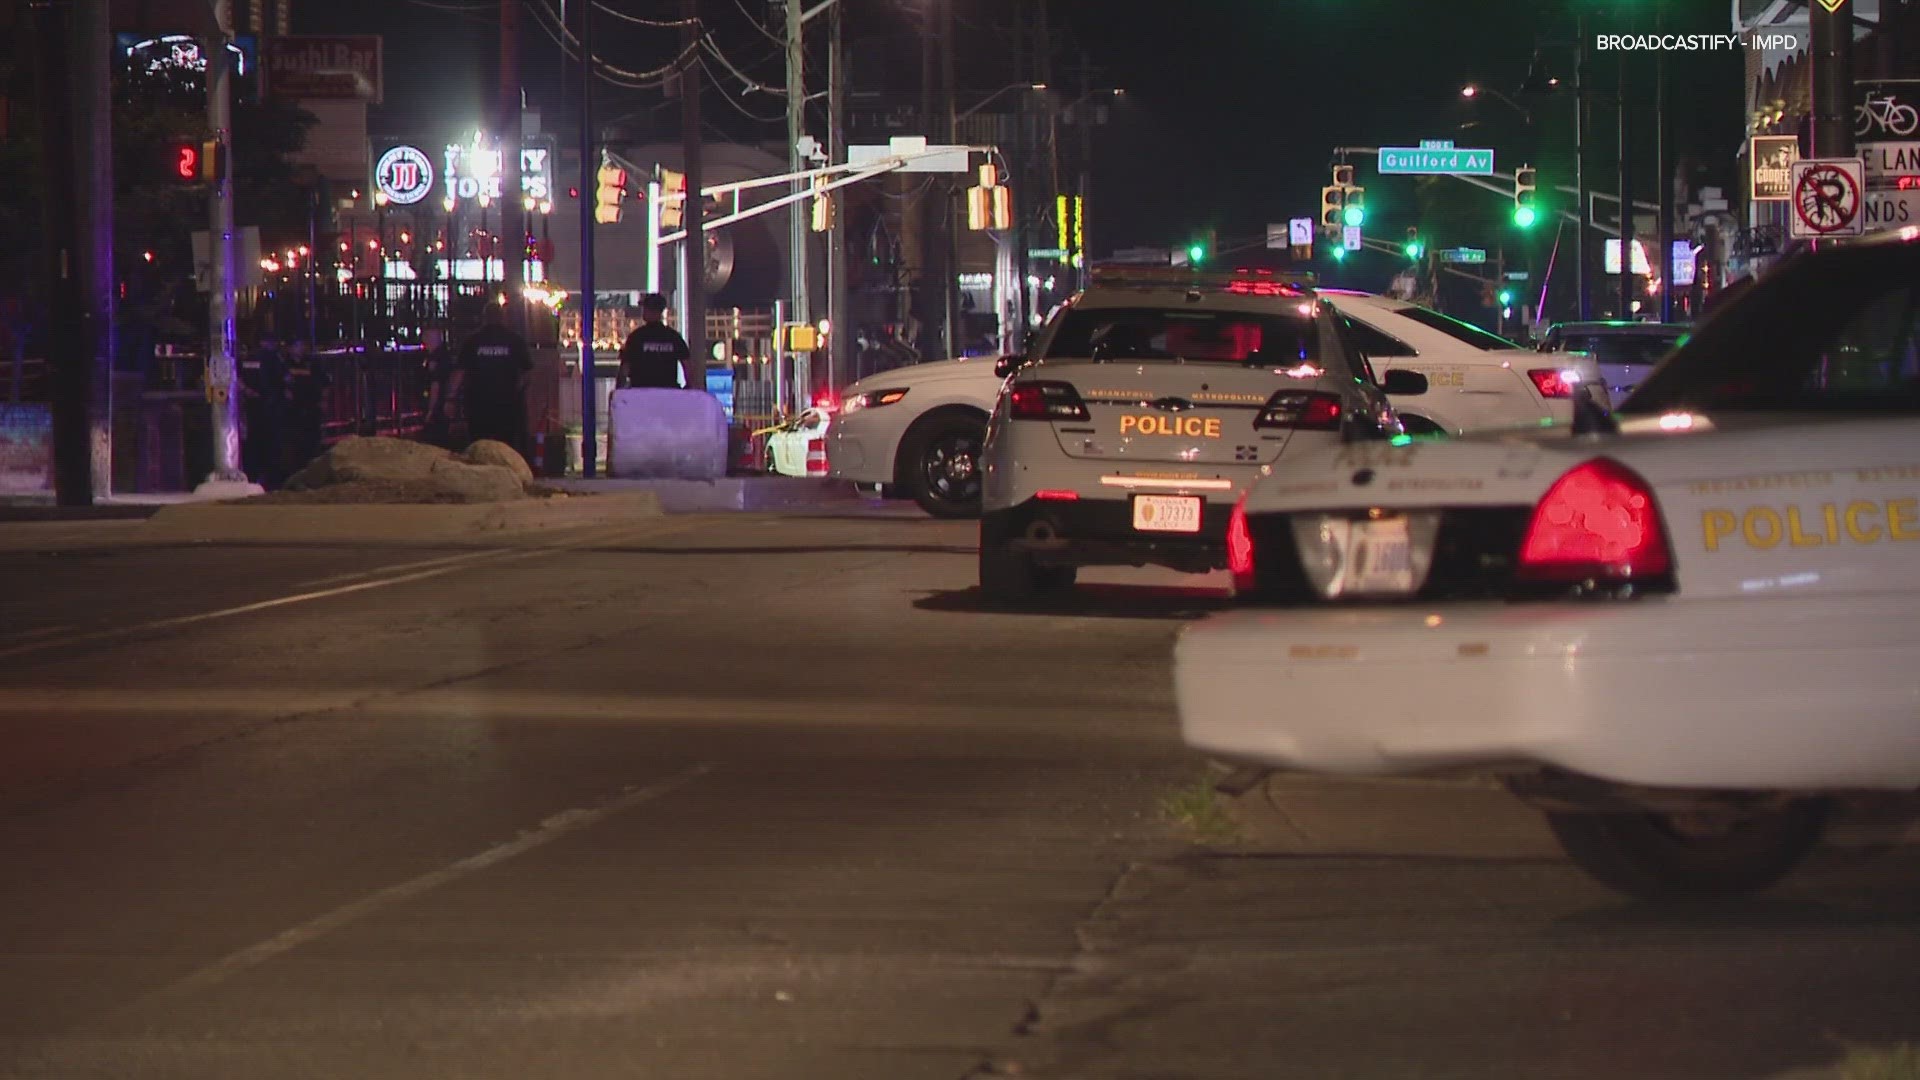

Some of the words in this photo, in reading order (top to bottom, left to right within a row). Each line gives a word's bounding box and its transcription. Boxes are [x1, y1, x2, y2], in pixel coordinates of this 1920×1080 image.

[333, 43, 374, 72] Bar
[1386, 153, 1458, 168] Guilford
[1466, 154, 1487, 169] Av
[1882, 147, 1920, 171] LAN
[391, 162, 417, 191] JJ
[444, 175, 548, 199] JOH'S
[1755, 168, 1791, 185] GOODFE
[1864, 199, 1909, 223] NDS
[1430, 371, 1464, 386] ICE
[1087, 388, 1154, 399] INDIANAPOLIS
[1191, 392, 1265, 402] METROPOLITAN
[1119, 414, 1221, 439] POLICE
[1159, 504, 1194, 521] 17373
[1701, 498, 1920, 552] POLICE
